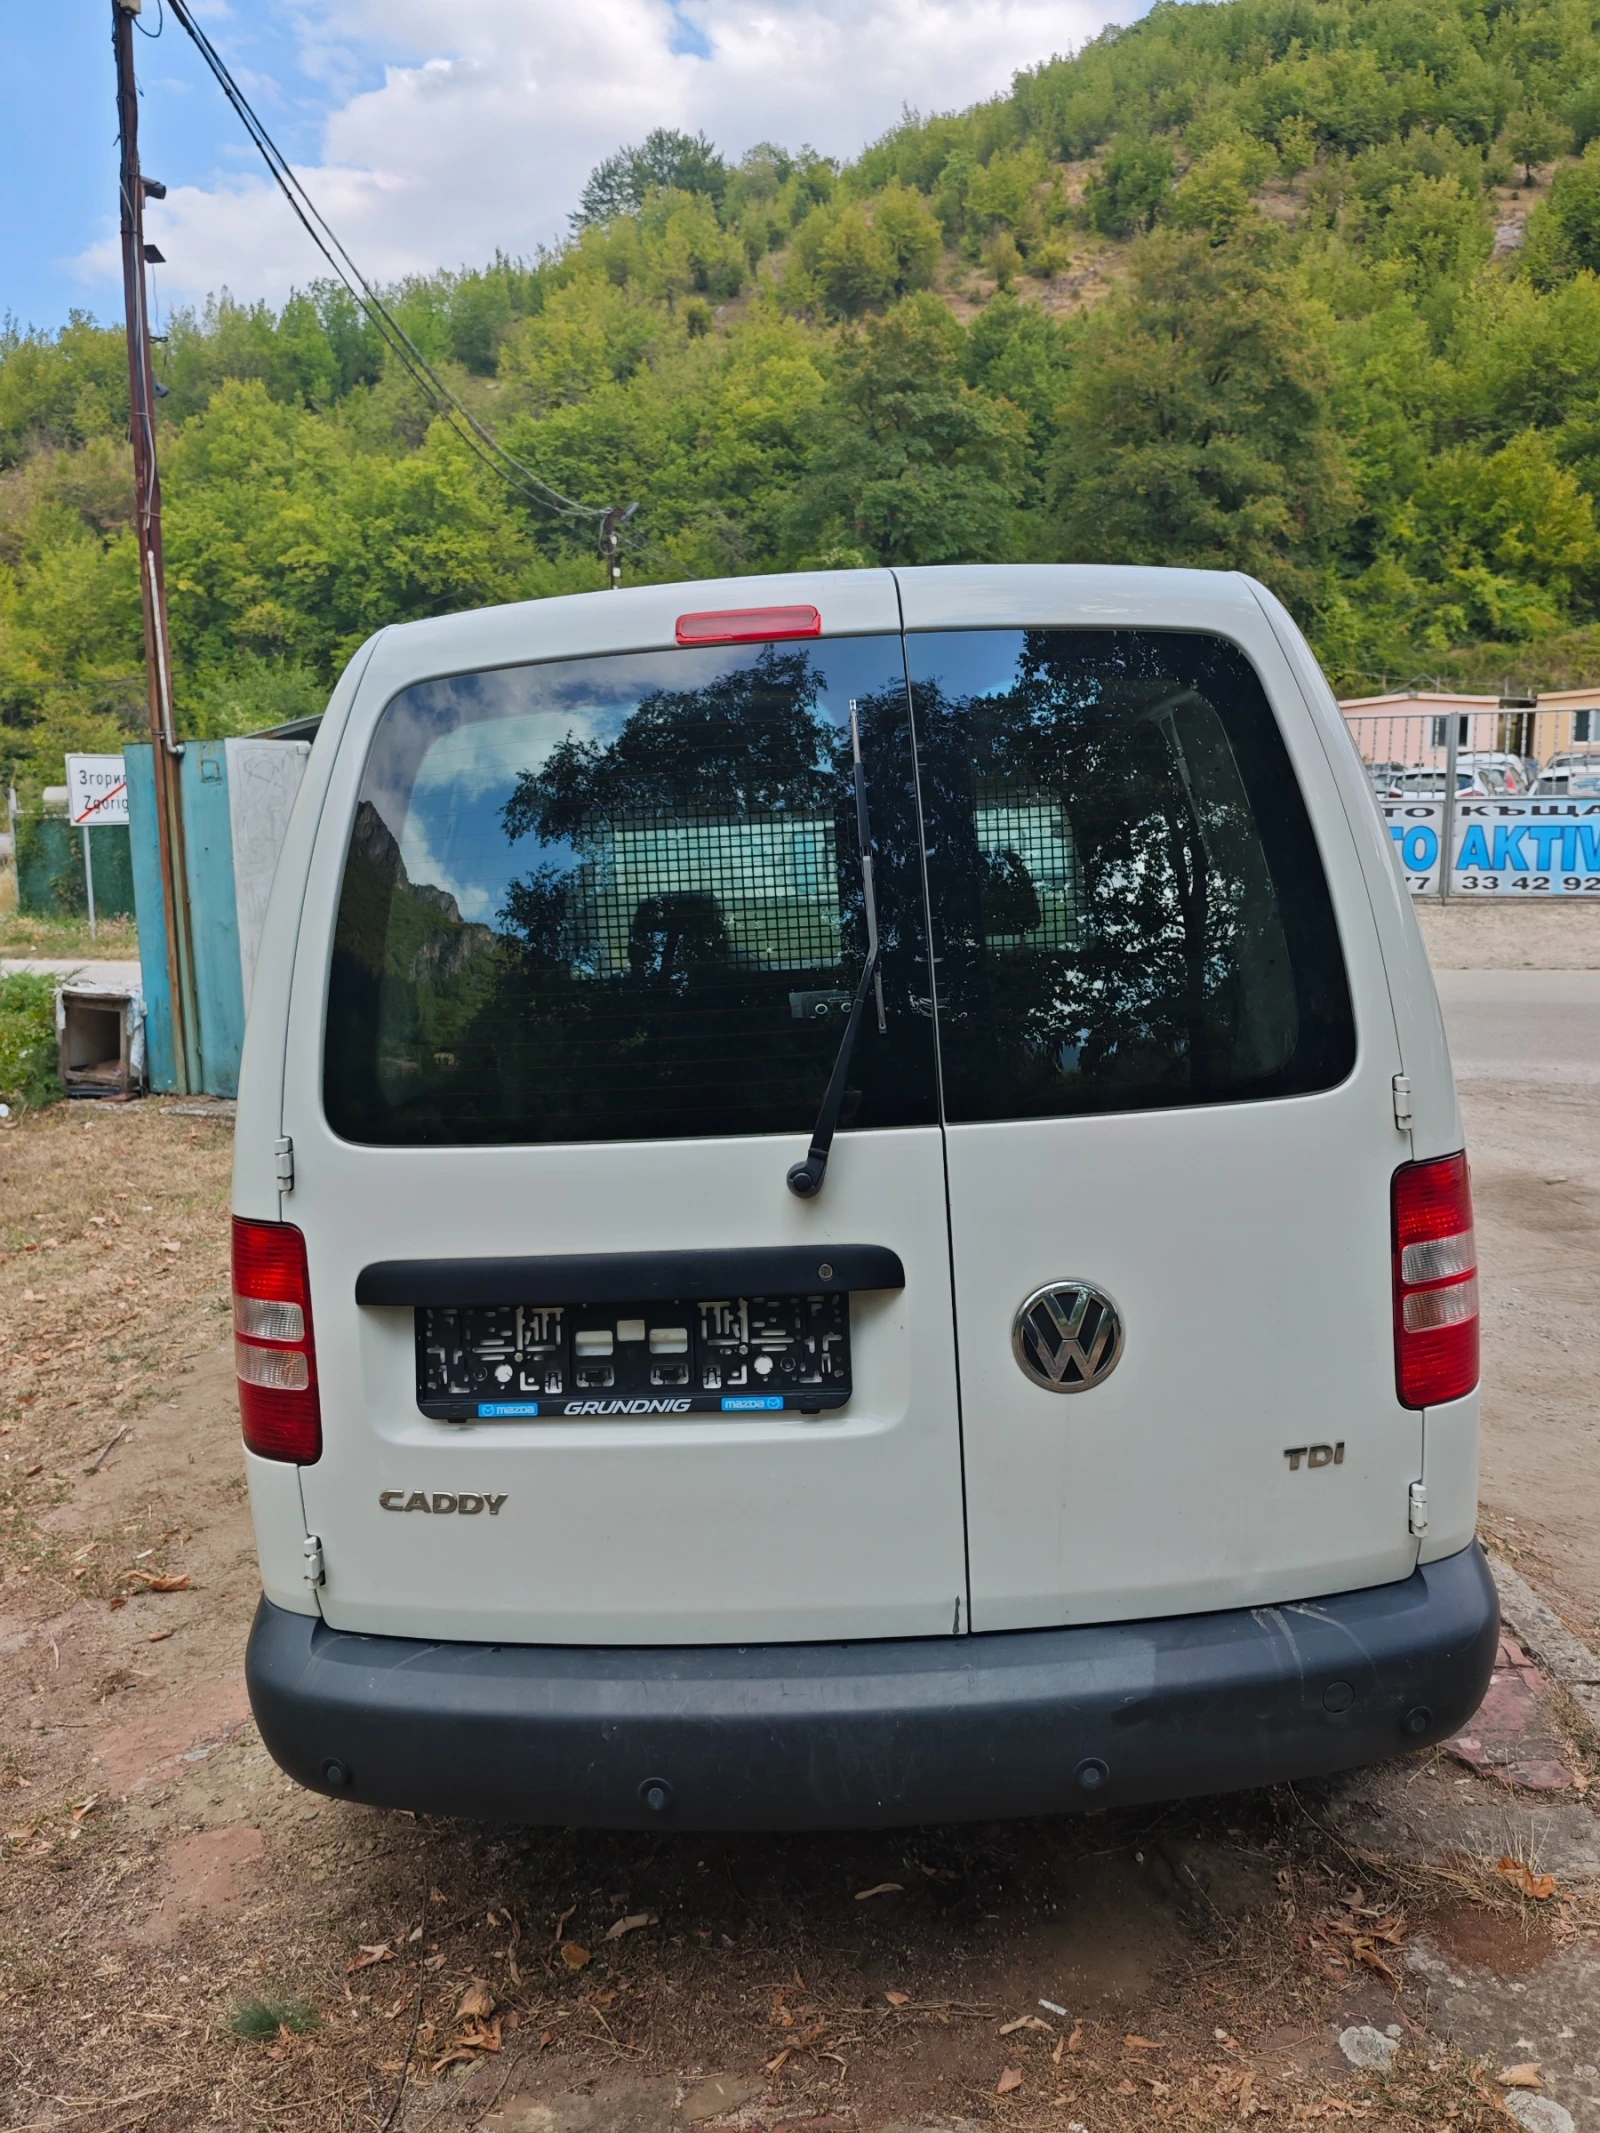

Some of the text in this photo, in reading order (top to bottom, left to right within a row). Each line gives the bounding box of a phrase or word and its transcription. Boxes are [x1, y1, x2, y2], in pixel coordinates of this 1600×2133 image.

[1462, 876, 1500, 890] 33
[1511, 876, 1550, 890] 42
[1562, 876, 1600, 891] 92
[496, 1398, 765, 1416] mazda GRUNDNIG mazda
[1283, 1441, 1345, 1471] TDI
[379, 1489, 510, 1516] CADDY
